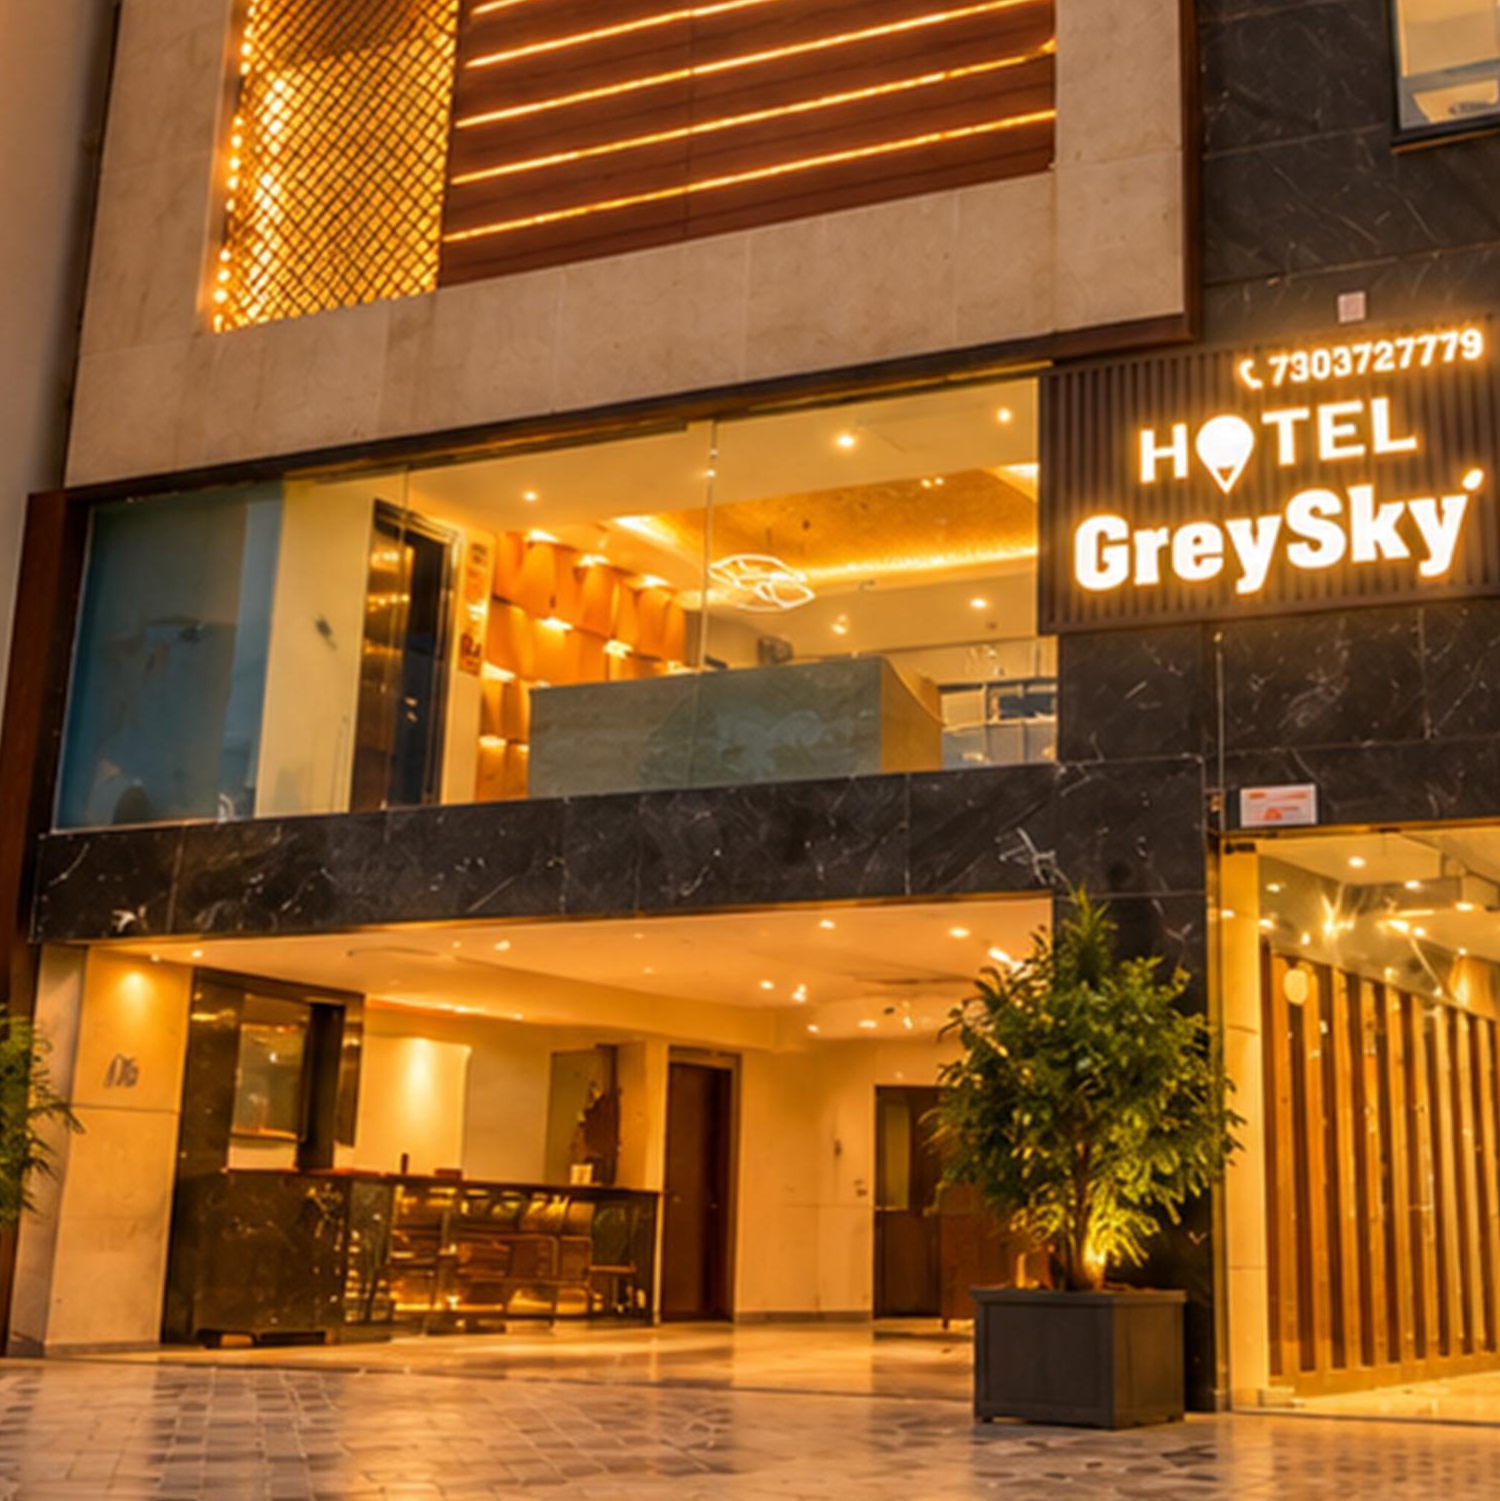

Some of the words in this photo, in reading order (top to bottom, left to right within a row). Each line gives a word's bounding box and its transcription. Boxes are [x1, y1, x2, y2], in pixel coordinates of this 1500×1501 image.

[1267, 327, 1486, 386] 7303727779
[1139, 396, 1419, 494] HOTEL
[1073, 468, 1485, 595] GreySky
